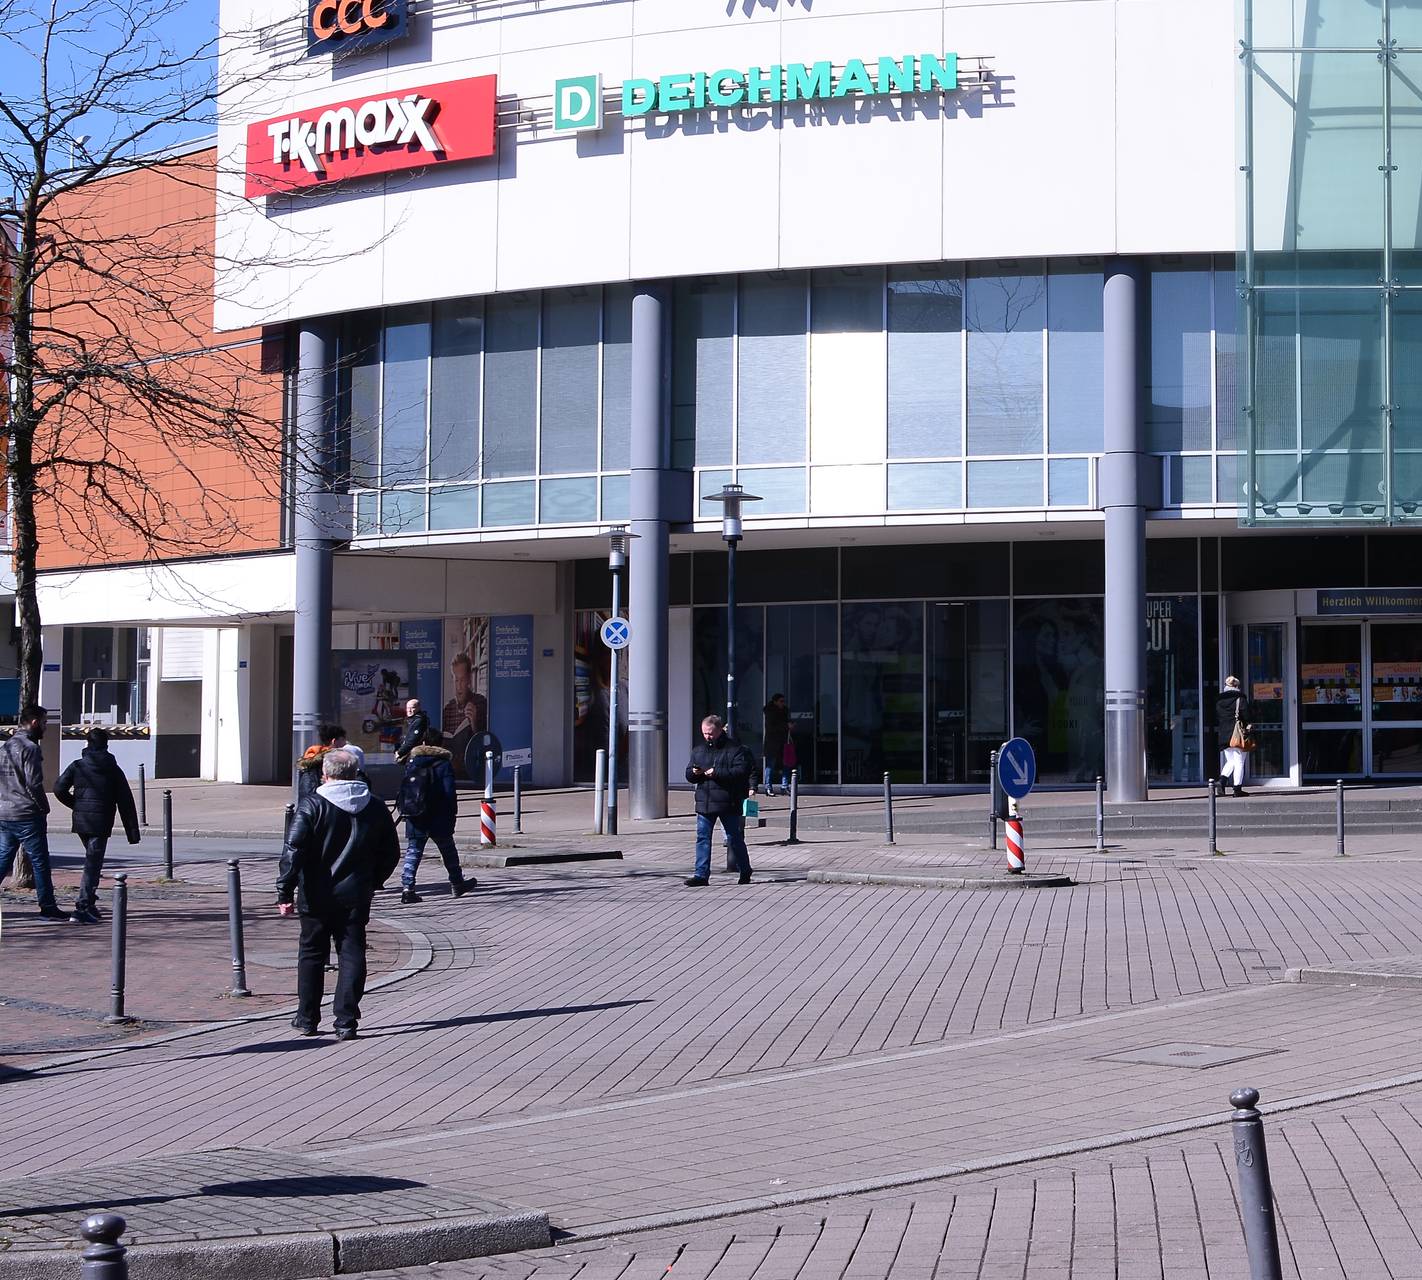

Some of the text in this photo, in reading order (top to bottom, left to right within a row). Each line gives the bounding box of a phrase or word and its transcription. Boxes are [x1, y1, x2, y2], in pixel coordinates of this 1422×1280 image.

[622, 53, 959, 116] DEICHMANN
[561, 86, 592, 122] D
[1322, 596, 1362, 607] Herzlich
